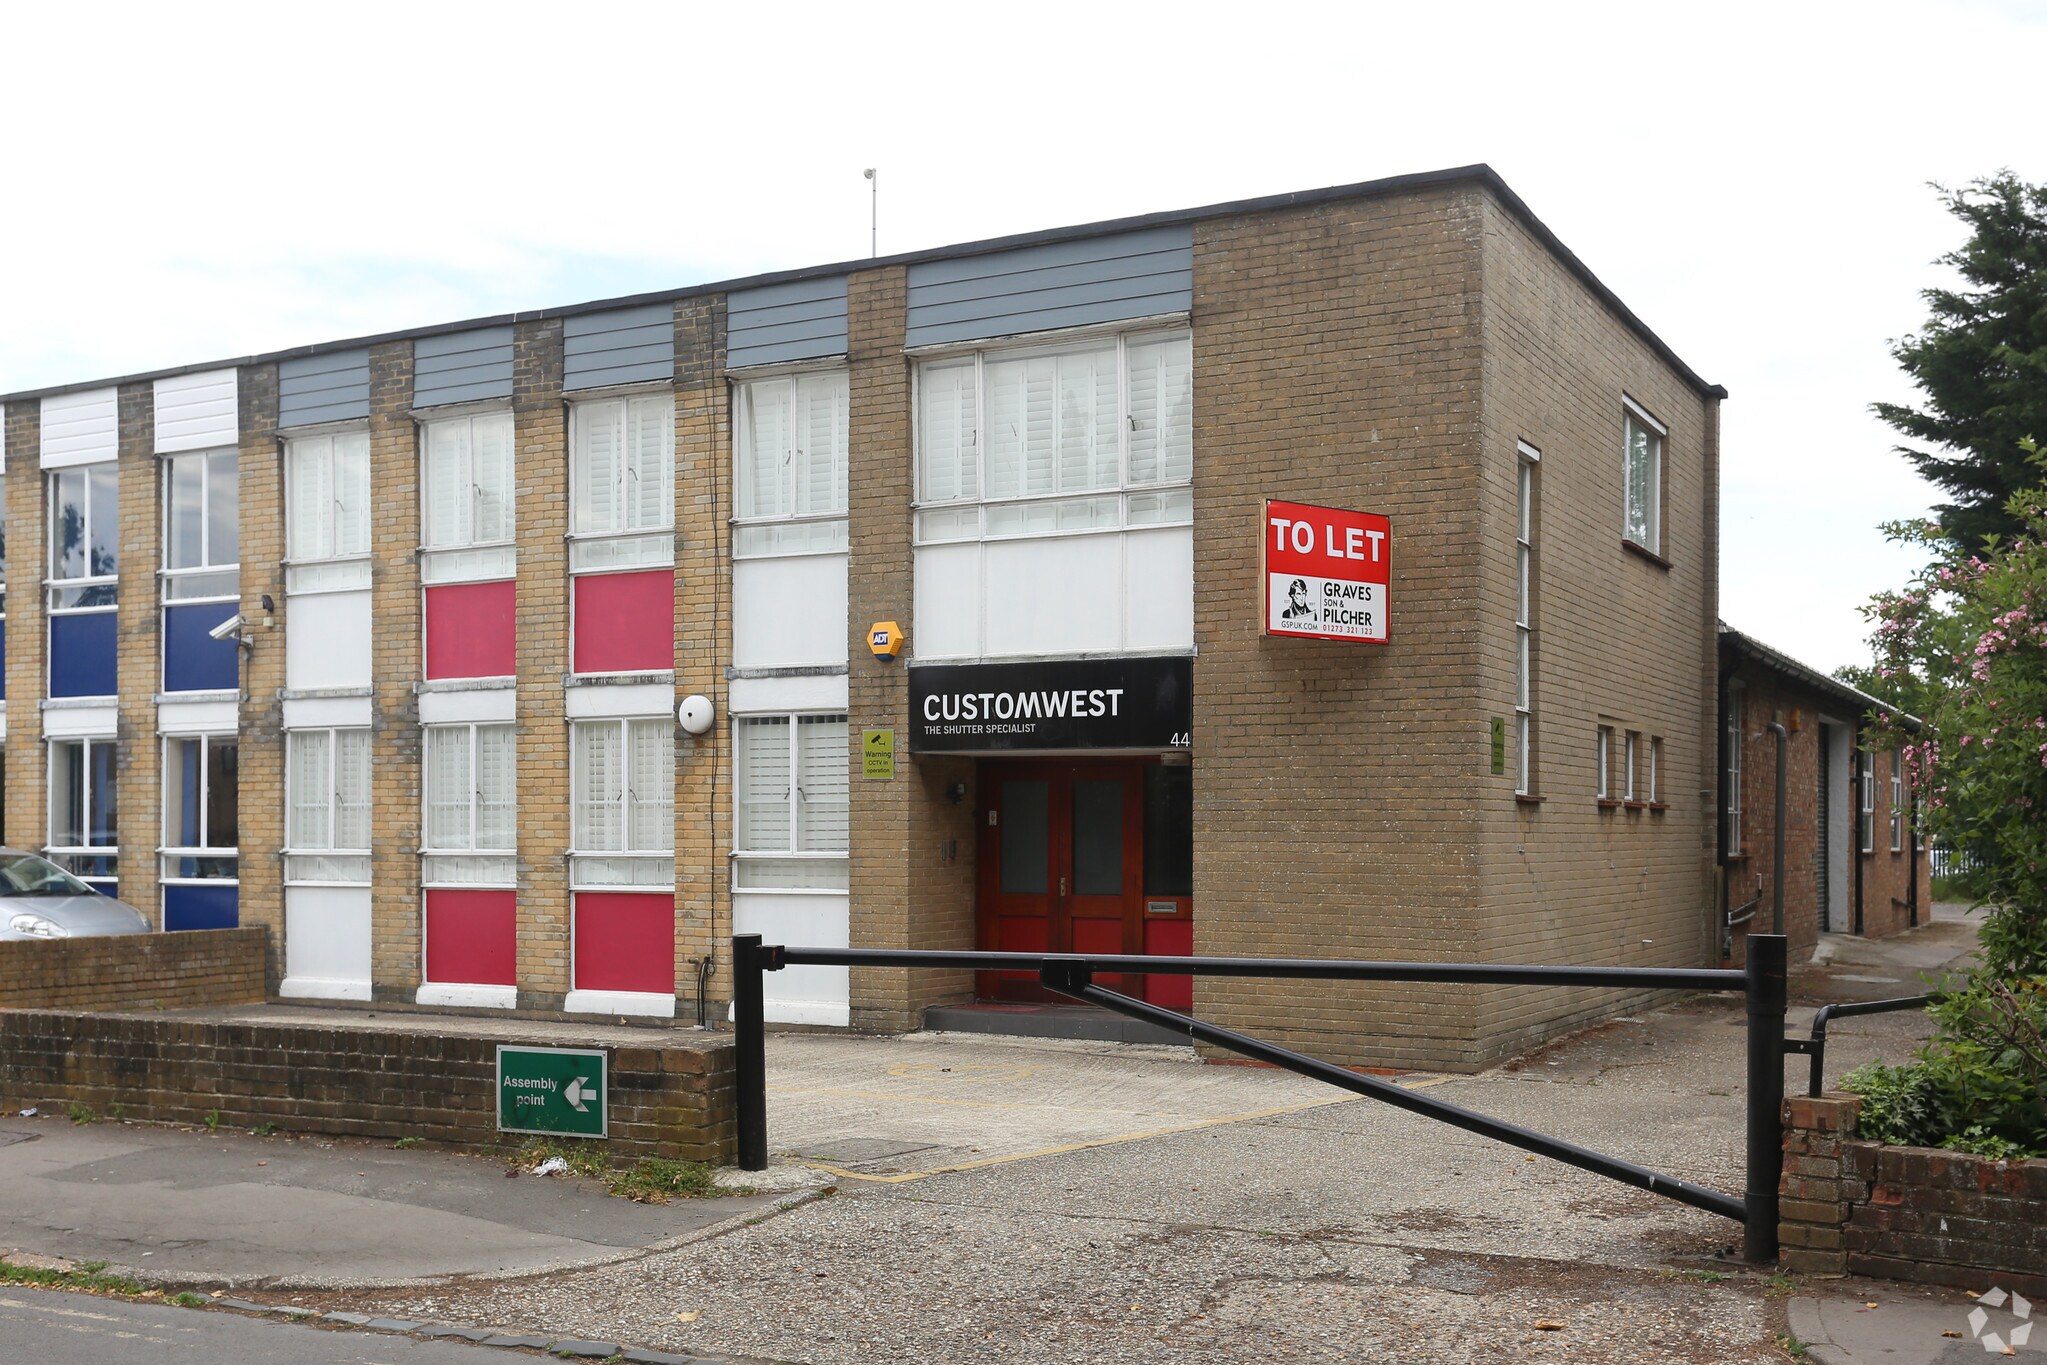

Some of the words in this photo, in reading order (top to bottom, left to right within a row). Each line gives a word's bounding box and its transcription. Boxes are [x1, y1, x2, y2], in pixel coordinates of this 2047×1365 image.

[1271, 518, 1315, 554] TO
[1326, 524, 1384, 562] LET
[1323, 582, 1372, 602] GRAVES
[1323, 599, 1338, 607] SON
[1323, 608, 1373, 626] PILCHER
[1322, 624, 1343, 633] 01273
[1346, 626, 1358, 634] 321
[1361, 627, 1373, 635] 123
[873, 633, 888, 644] ADT
[923, 689, 1124, 721] CUSTOMWEST
[924, 725, 941, 735] THE
[943, 724, 984, 735] SHUTTER
[985, 723, 1036, 734] SPECIALIST
[1170, 732, 1190, 747] 44
[865, 751, 892, 759] Warning
[503, 1075, 558, 1092] Assembly
[516, 1094, 545, 1107] point
